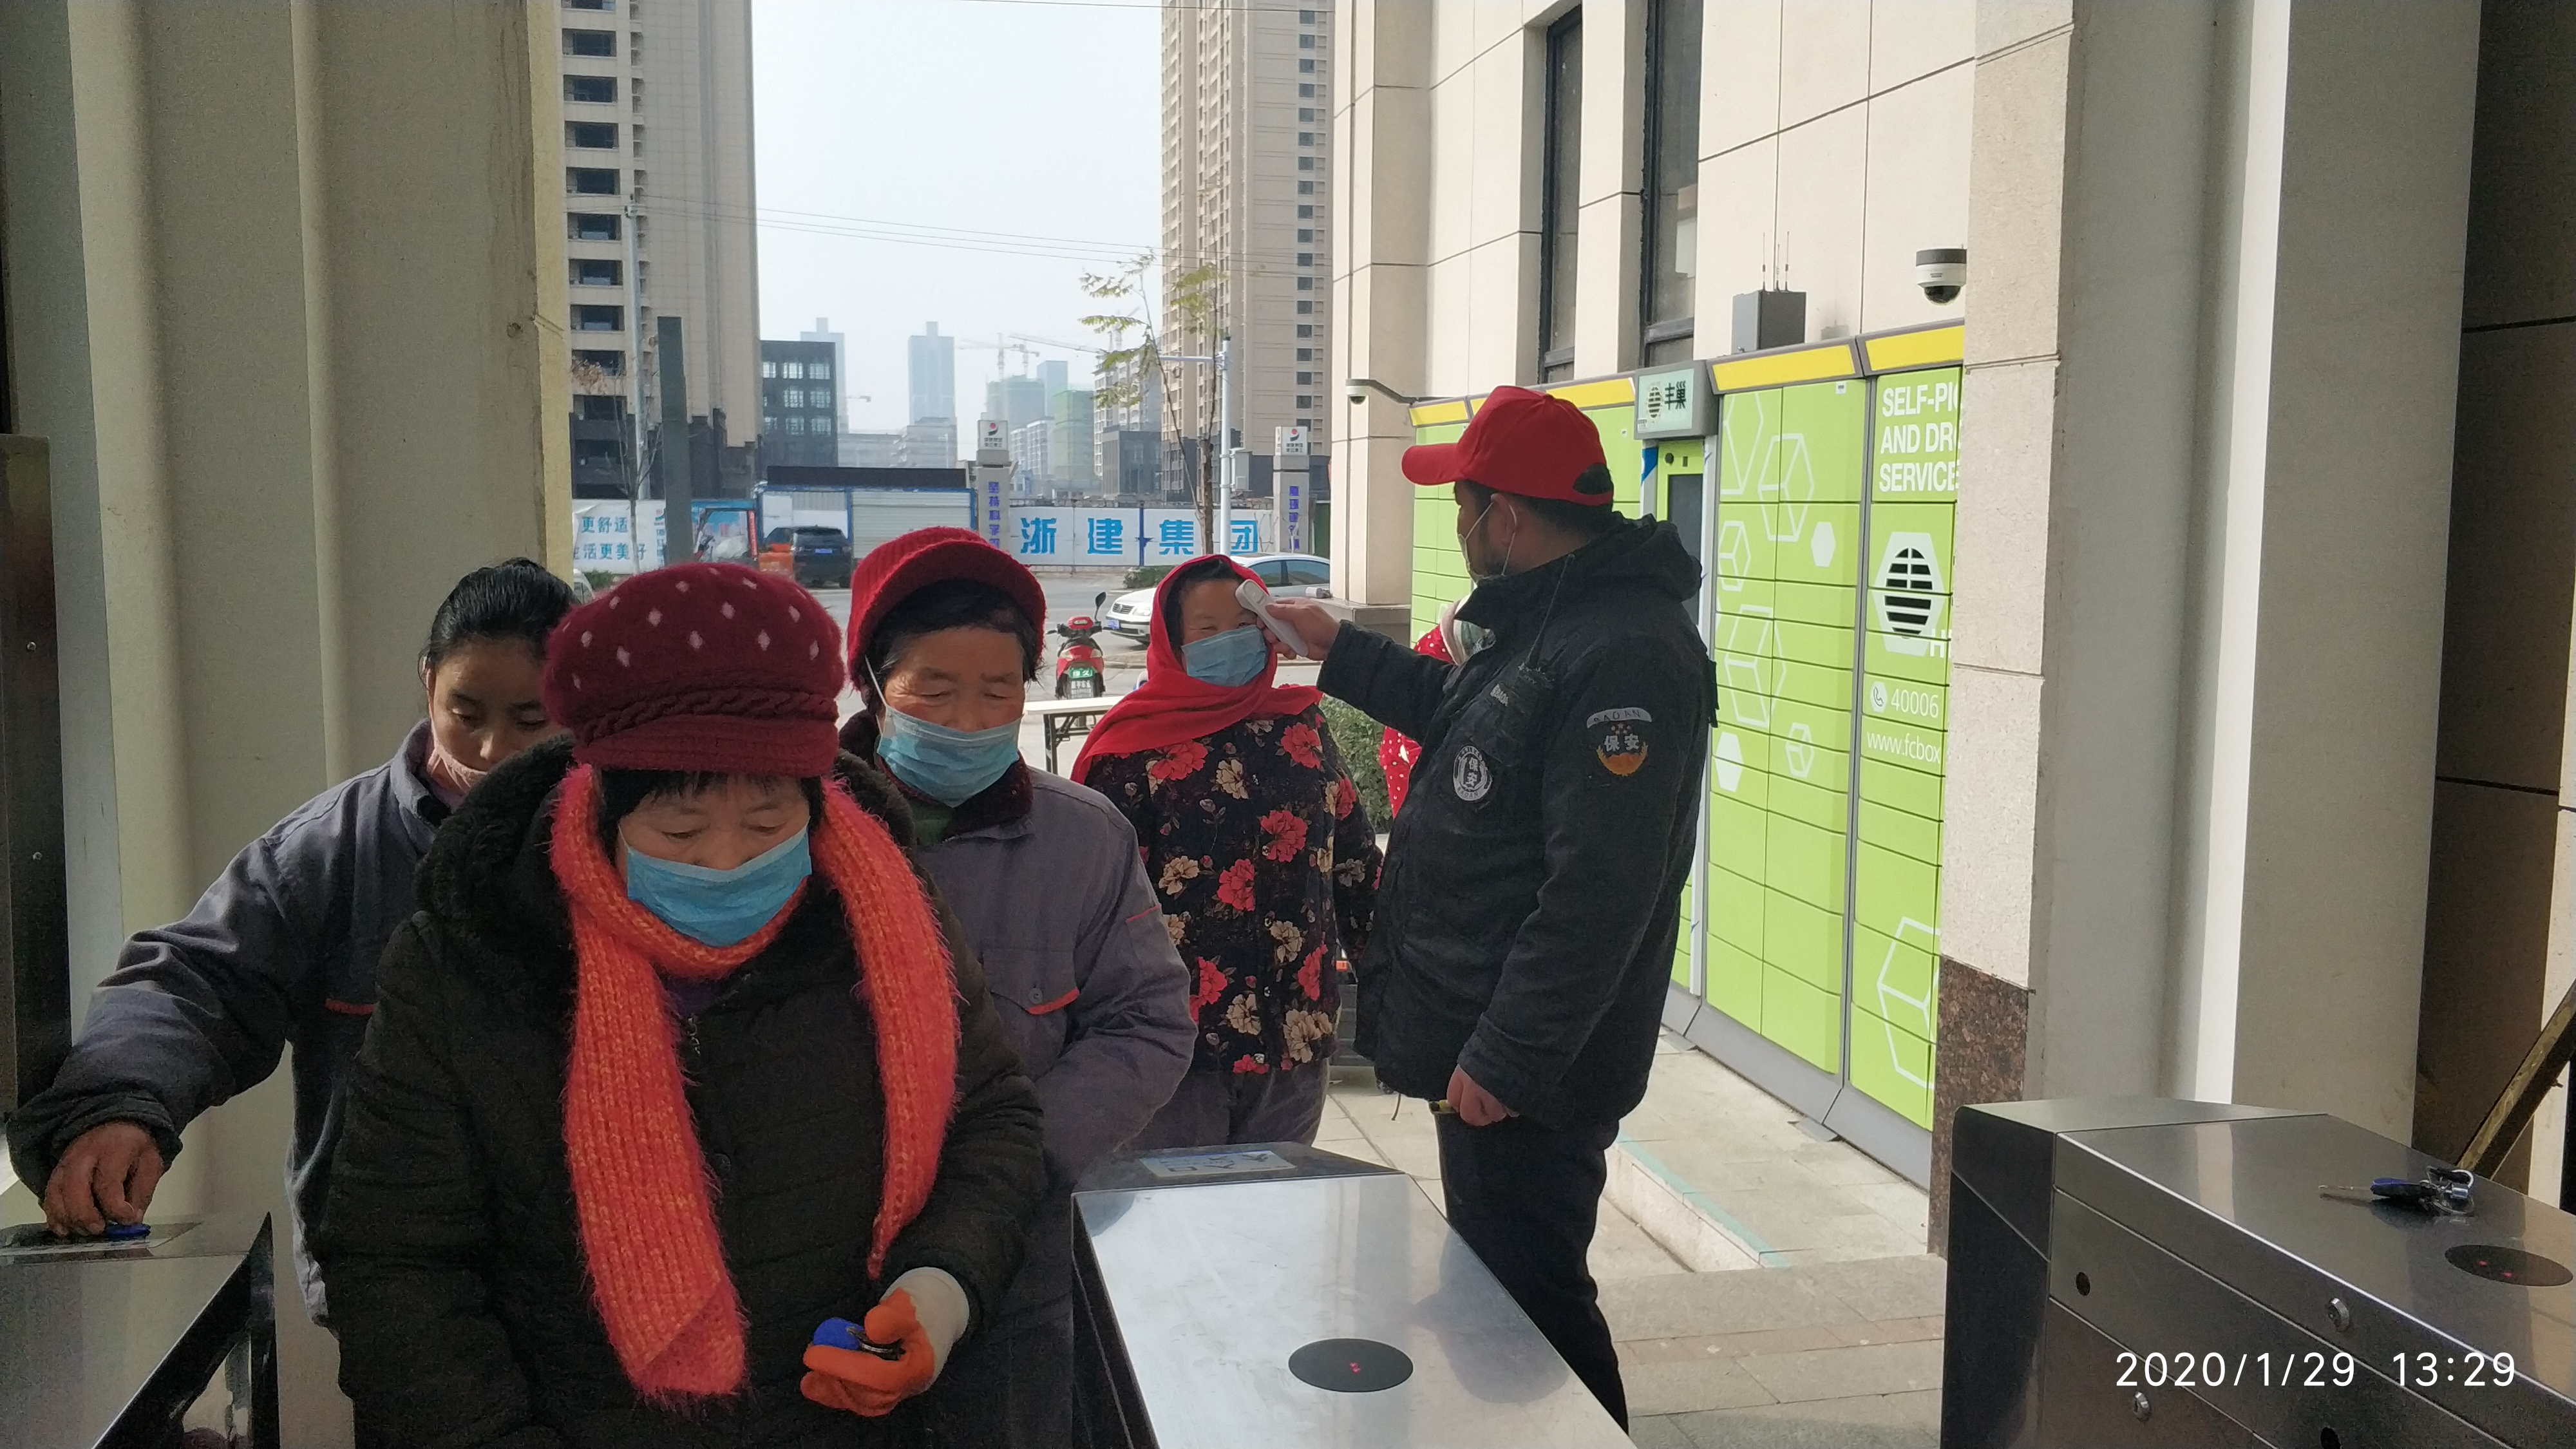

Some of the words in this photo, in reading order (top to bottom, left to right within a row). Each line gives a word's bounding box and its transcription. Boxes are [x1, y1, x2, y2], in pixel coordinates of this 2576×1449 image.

[1664, 381, 1687, 410] 丰巢
[1880, 424, 1920, 454] AND
[582, 516, 629, 533] 更舒适
[1020, 516, 1259, 555] 浙建集团
[1891, 688, 1939, 719] 40006
[1604, 734, 1640, 752] 保安
[1465, 757, 1479, 786] 保安
